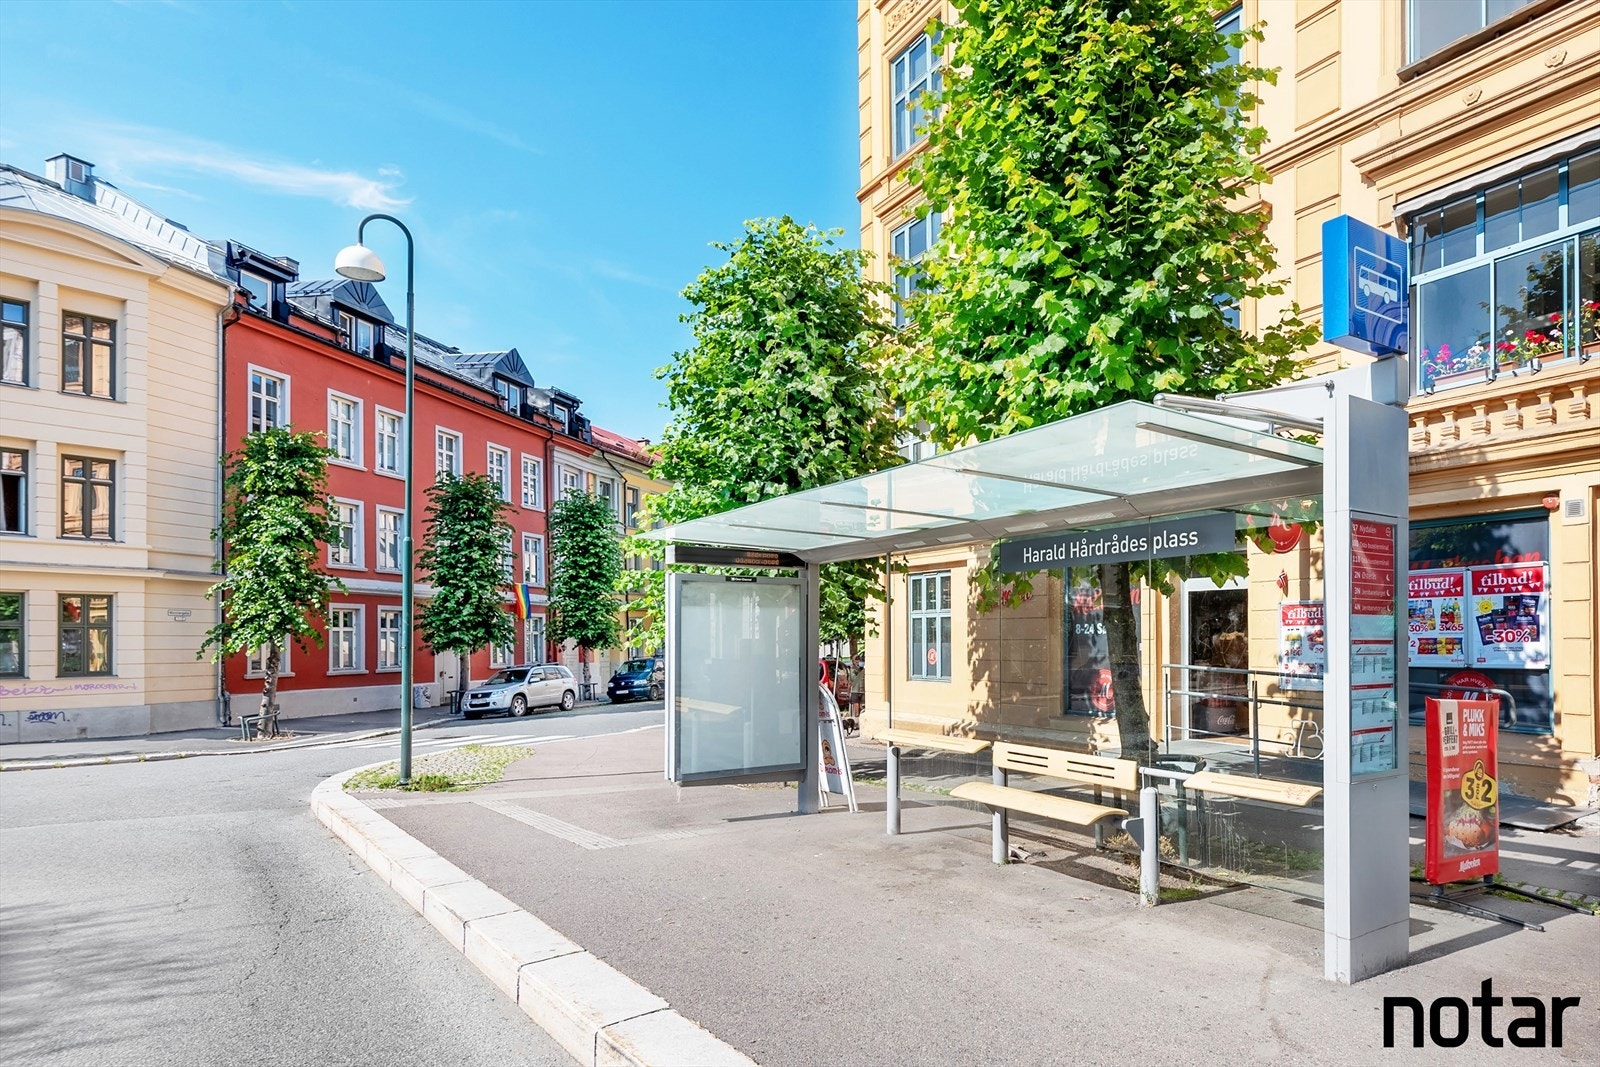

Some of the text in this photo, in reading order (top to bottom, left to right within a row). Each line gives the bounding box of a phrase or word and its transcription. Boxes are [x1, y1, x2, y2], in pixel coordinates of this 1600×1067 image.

[1023, 530, 1199, 564] Harald Hårdrådes plass
[1408, 576, 1454, 591] tilbud!
[1480, 570, 1533, 587] tilbud!
[1075, 623, 1095, 635] 8-24
[1486, 628, 1530, 643] -30%
[1463, 708, 1484, 722] PLUKK
[1464, 724, 1485, 736] & MIKS
[1465, 777, 1474, 800] 3
[1480, 778, 1492, 803] 2
